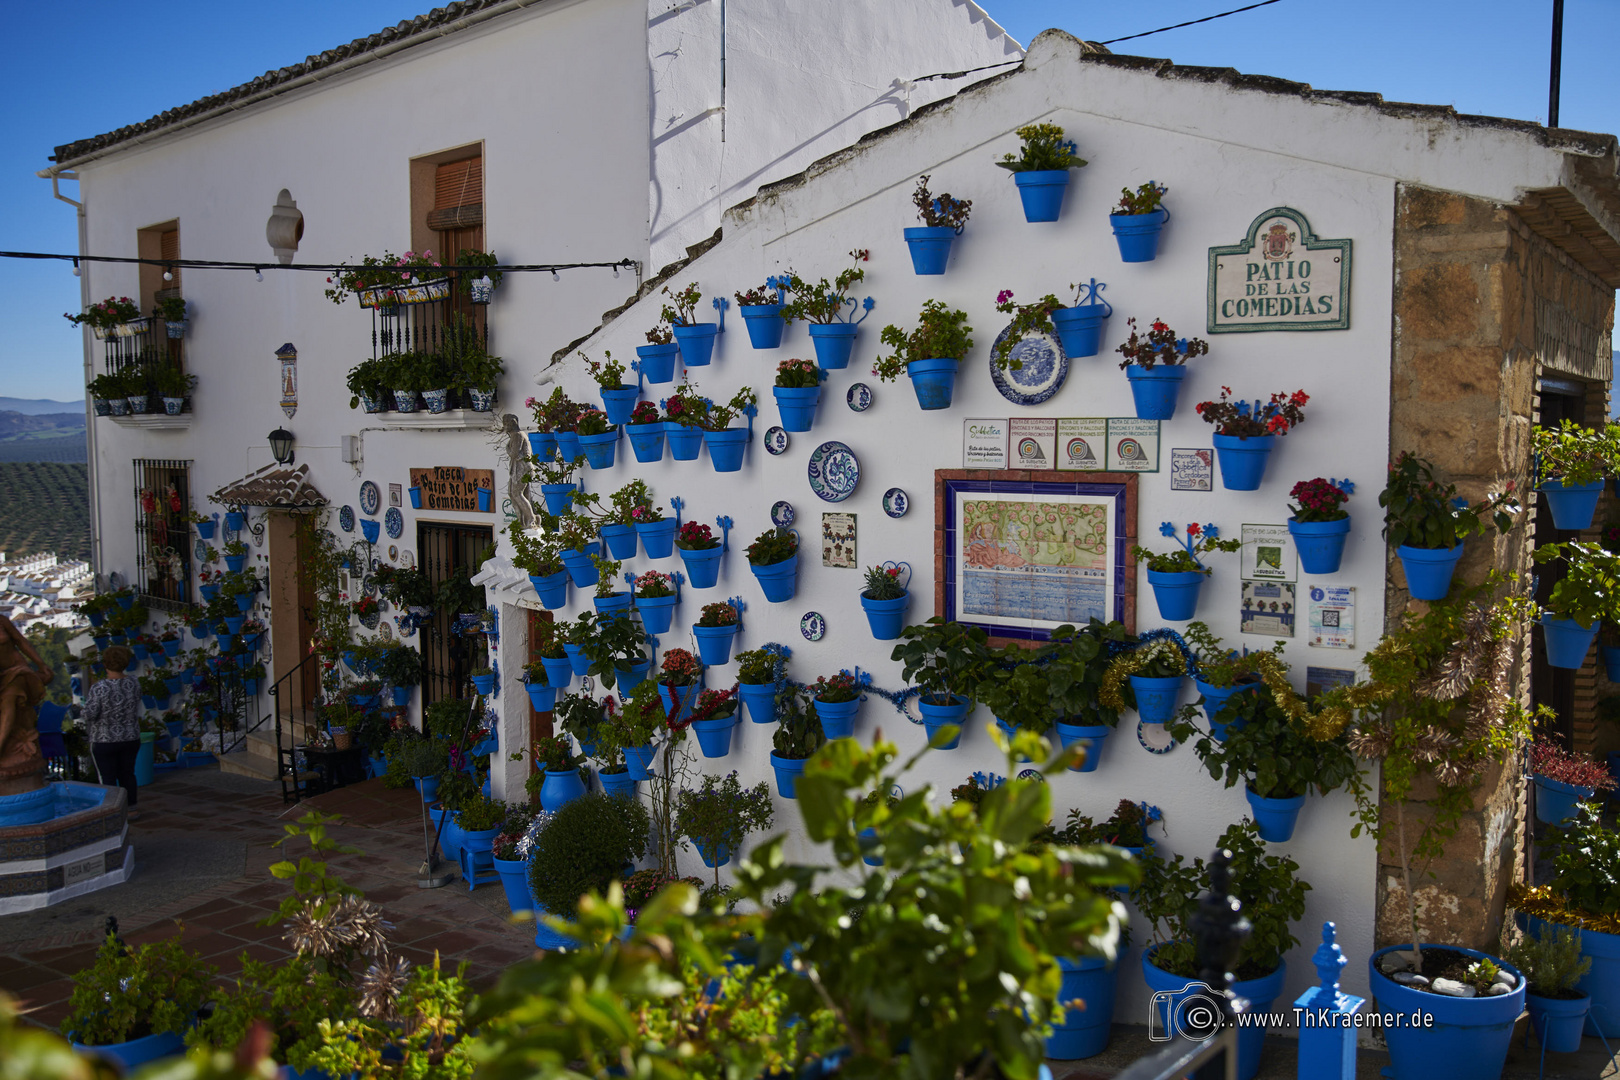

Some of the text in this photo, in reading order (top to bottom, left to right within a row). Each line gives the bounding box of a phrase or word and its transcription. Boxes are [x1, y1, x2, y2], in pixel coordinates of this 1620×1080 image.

[1246, 260, 1311, 282] PATIO
[1246, 281, 1311, 296] DE LAS
[1222, 295, 1333, 318] COMEDIAS
[434, 467, 462, 480] Tasca
[421, 473, 478, 496] Patio de las
[428, 494, 475, 510] Comedias
